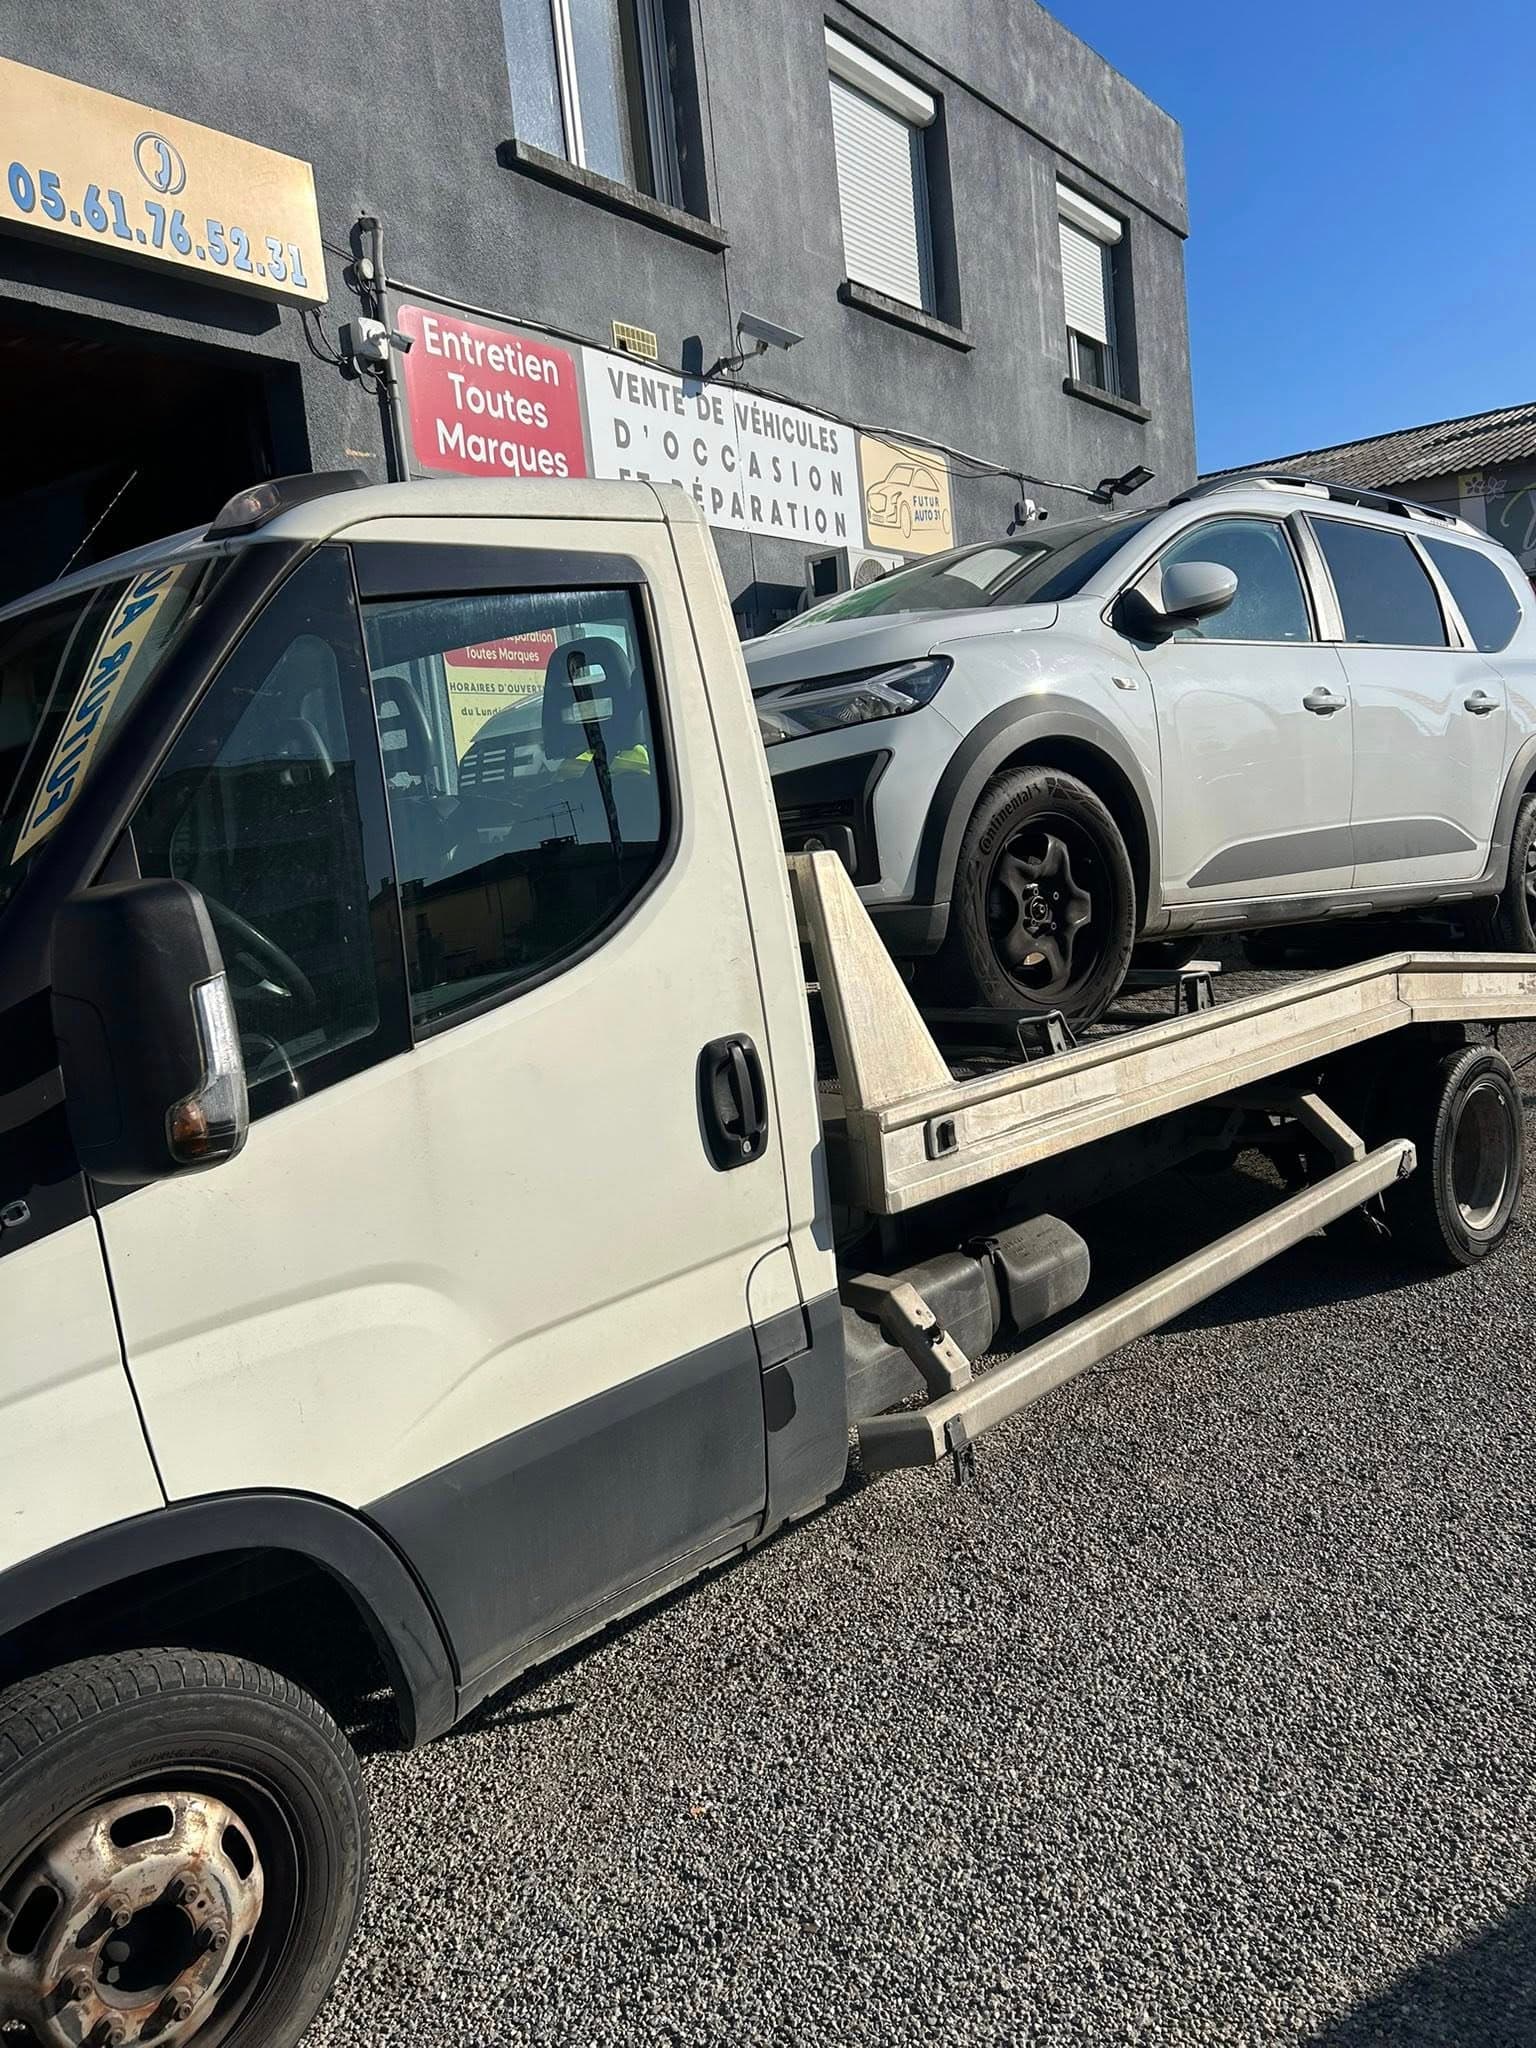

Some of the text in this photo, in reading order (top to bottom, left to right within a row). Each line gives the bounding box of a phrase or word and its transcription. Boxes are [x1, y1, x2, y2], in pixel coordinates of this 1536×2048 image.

[7, 161, 307, 288] 05.61.76.52.31
[422, 316, 560, 387] Entretien
[448, 372, 549, 428] Toutes
[607, 367, 839, 455] VENTE DE VÉHICULES
[436, 418, 569, 477] Marques
[672, 477, 847, 538] ÉPARATION
[913, 495, 940, 507] FUTUR
[914, 509, 942, 522] AUTO 31
[465, 646, 540, 664] Toutes Marques
[503, 631, 553, 645] paration
[449, 682, 544, 693] HORAIRES D'OUVERT
[460, 706, 474, 716] du
[979, 785, 1033, 855] Continental
